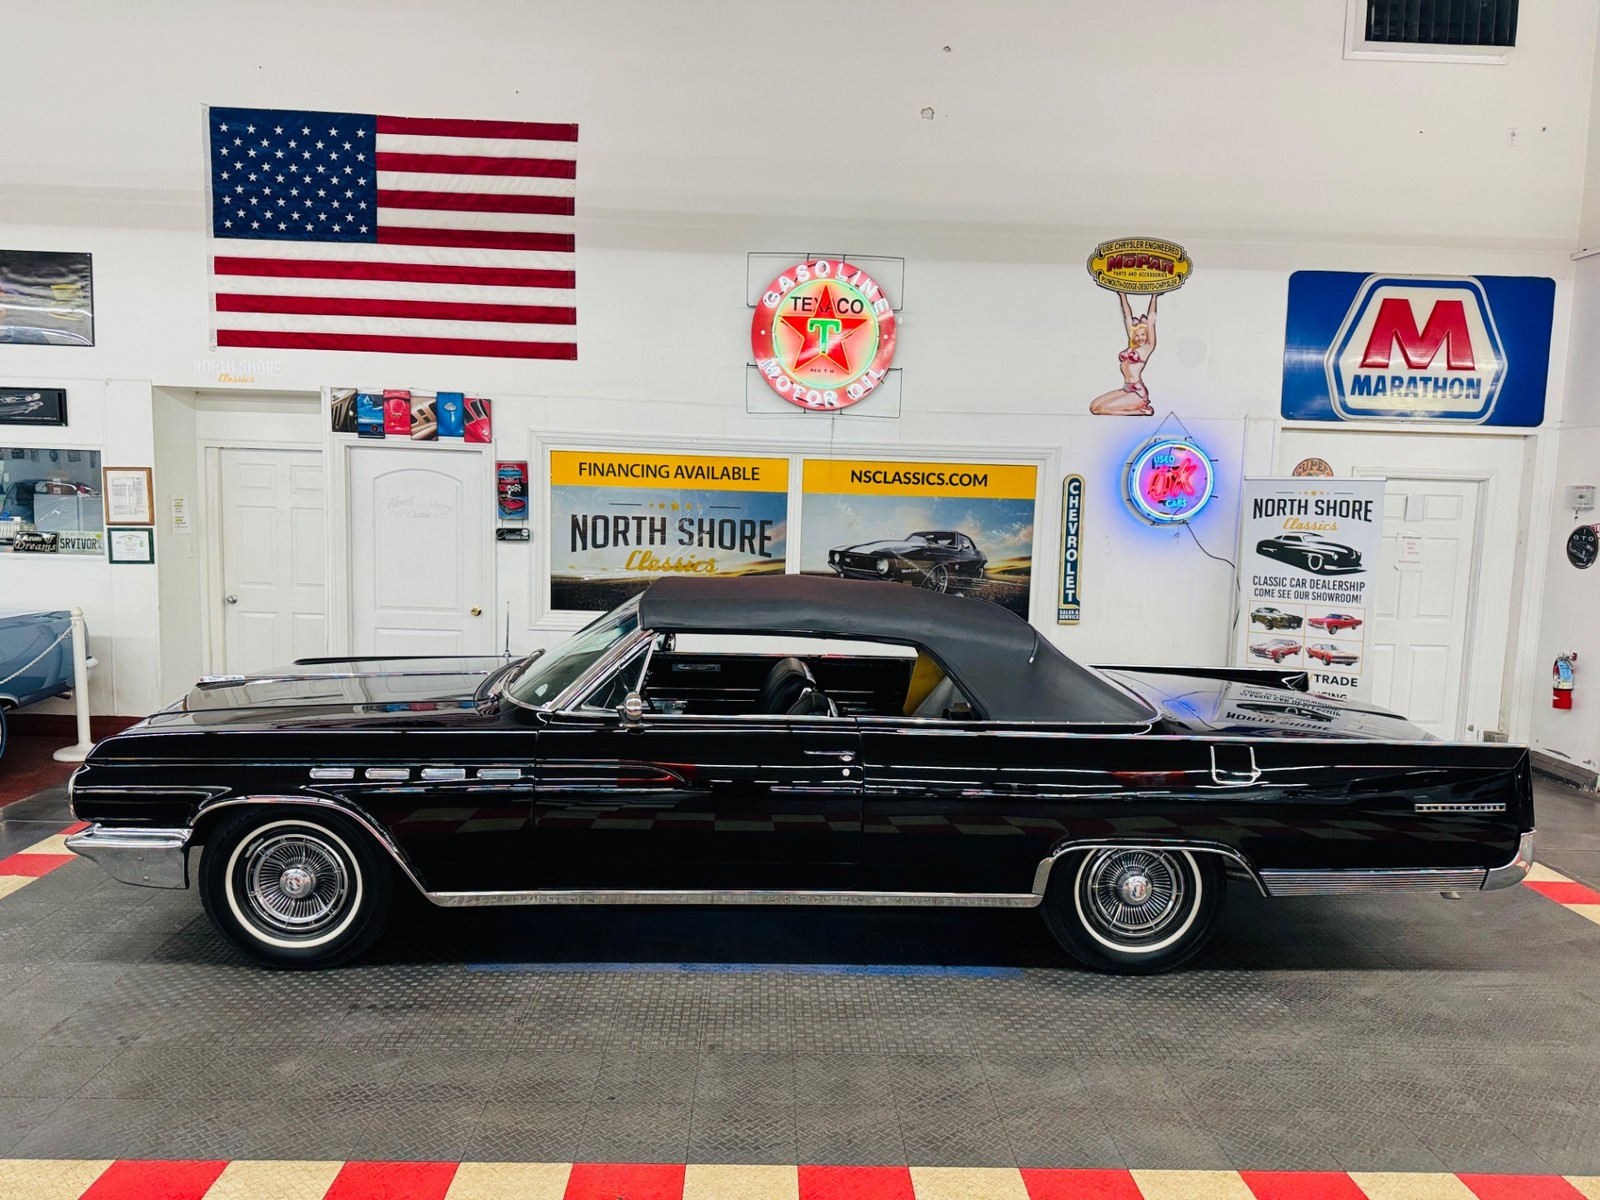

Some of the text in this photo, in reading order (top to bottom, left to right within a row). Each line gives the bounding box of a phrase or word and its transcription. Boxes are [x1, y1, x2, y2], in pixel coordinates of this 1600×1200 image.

[1102, 241, 1180, 256] USE CHRYSLER ENGINEERED
[1106, 253, 1175, 275] MOPAR
[762, 260, 890, 316] GASOLINE
[790, 296, 865, 315] TEXACO
[193, 359, 235, 375] NORTH
[218, 372, 256, 383] Classics
[761, 358, 885, 407] MOTOR OIL
[1350, 374, 1482, 399] MARATHON
[1153, 455, 1175, 463] USED
[577, 461, 761, 481] FINANCING AVAILABLE
[850, 469, 989, 488] NSCLASSICS.COM
[1148, 457, 1198, 502] OK
[1165, 499, 1187, 508] CARS
[1253, 498, 1373, 522] NORTH SHORE
[1282, 517, 1338, 531] Classics
[571, 513, 773, 558] NORTH SHORE
[1065, 482, 1080, 602] CHEVROLET
[1573, 534, 1595, 542] GTO
[625, 549, 719, 575] Classics
[1253, 575, 1366, 592] CLASSIC CAR DEALERSHIP
[1254, 588, 1362, 604] COME SEE OUR SHOWROOM!
